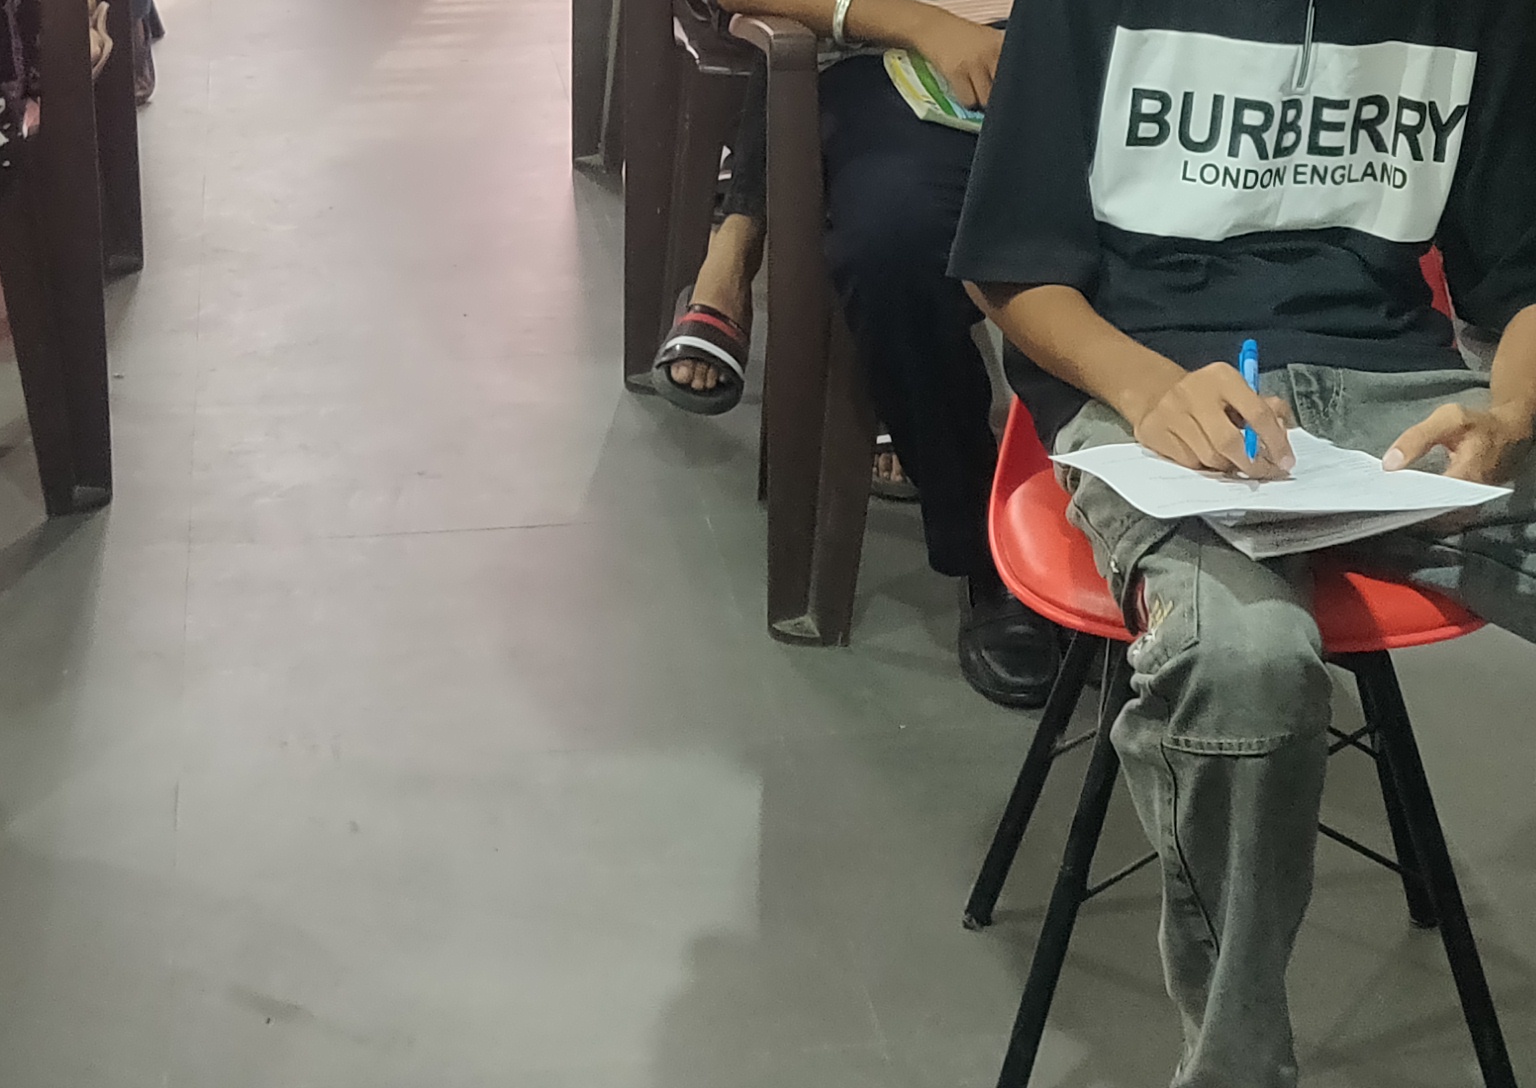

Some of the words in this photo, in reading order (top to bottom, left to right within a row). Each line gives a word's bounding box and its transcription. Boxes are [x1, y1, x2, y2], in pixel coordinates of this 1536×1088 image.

[1125, 88, 1469, 163] BURBERRY
[1181, 160, 1287, 190] LONDON
[1293, 161, 1408, 190] ENGLAND
